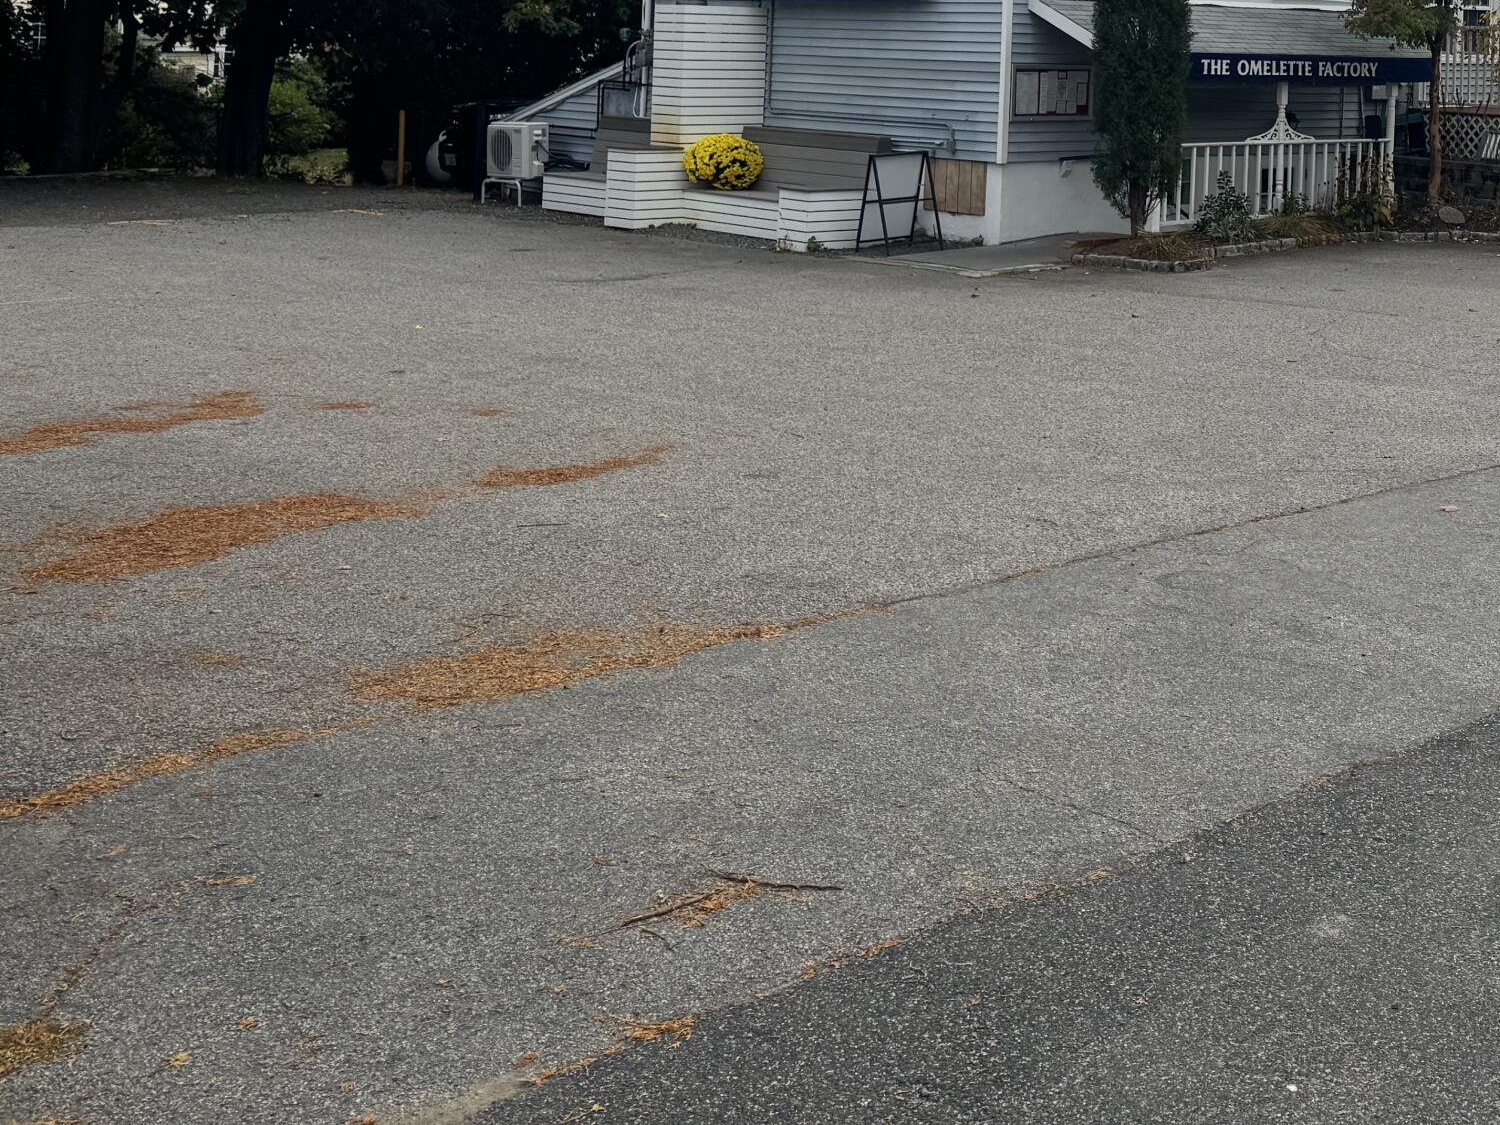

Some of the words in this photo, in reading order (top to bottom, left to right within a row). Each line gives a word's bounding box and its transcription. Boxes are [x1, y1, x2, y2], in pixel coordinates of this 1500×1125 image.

[1201, 59, 1231, 75] THE
[1237, 59, 1312, 76] OMELETTE
[1318, 61, 1378, 77] FACTORY
